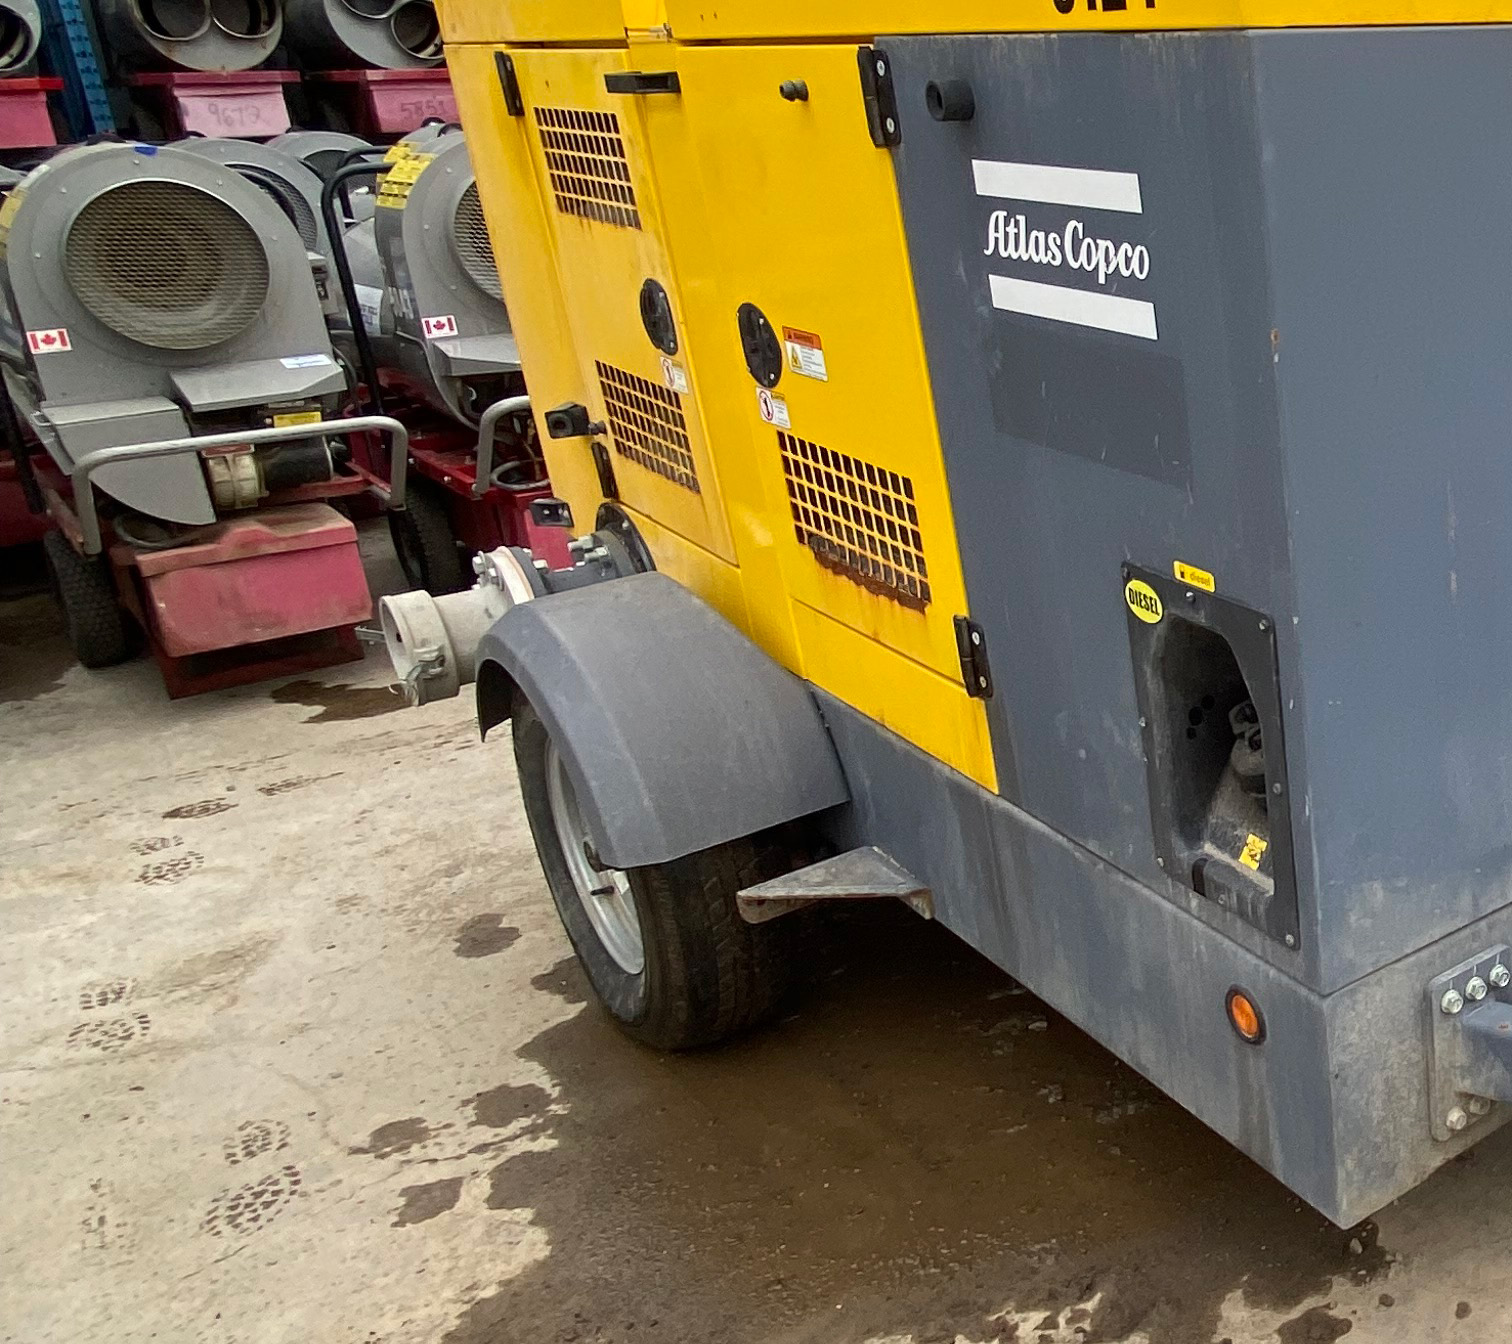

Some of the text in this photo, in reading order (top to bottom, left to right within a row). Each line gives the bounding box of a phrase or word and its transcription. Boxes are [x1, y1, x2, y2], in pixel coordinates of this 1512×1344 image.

[983, 209, 1151, 285] Atlas Copco
[1128, 586, 1160, 617] DIESEL
